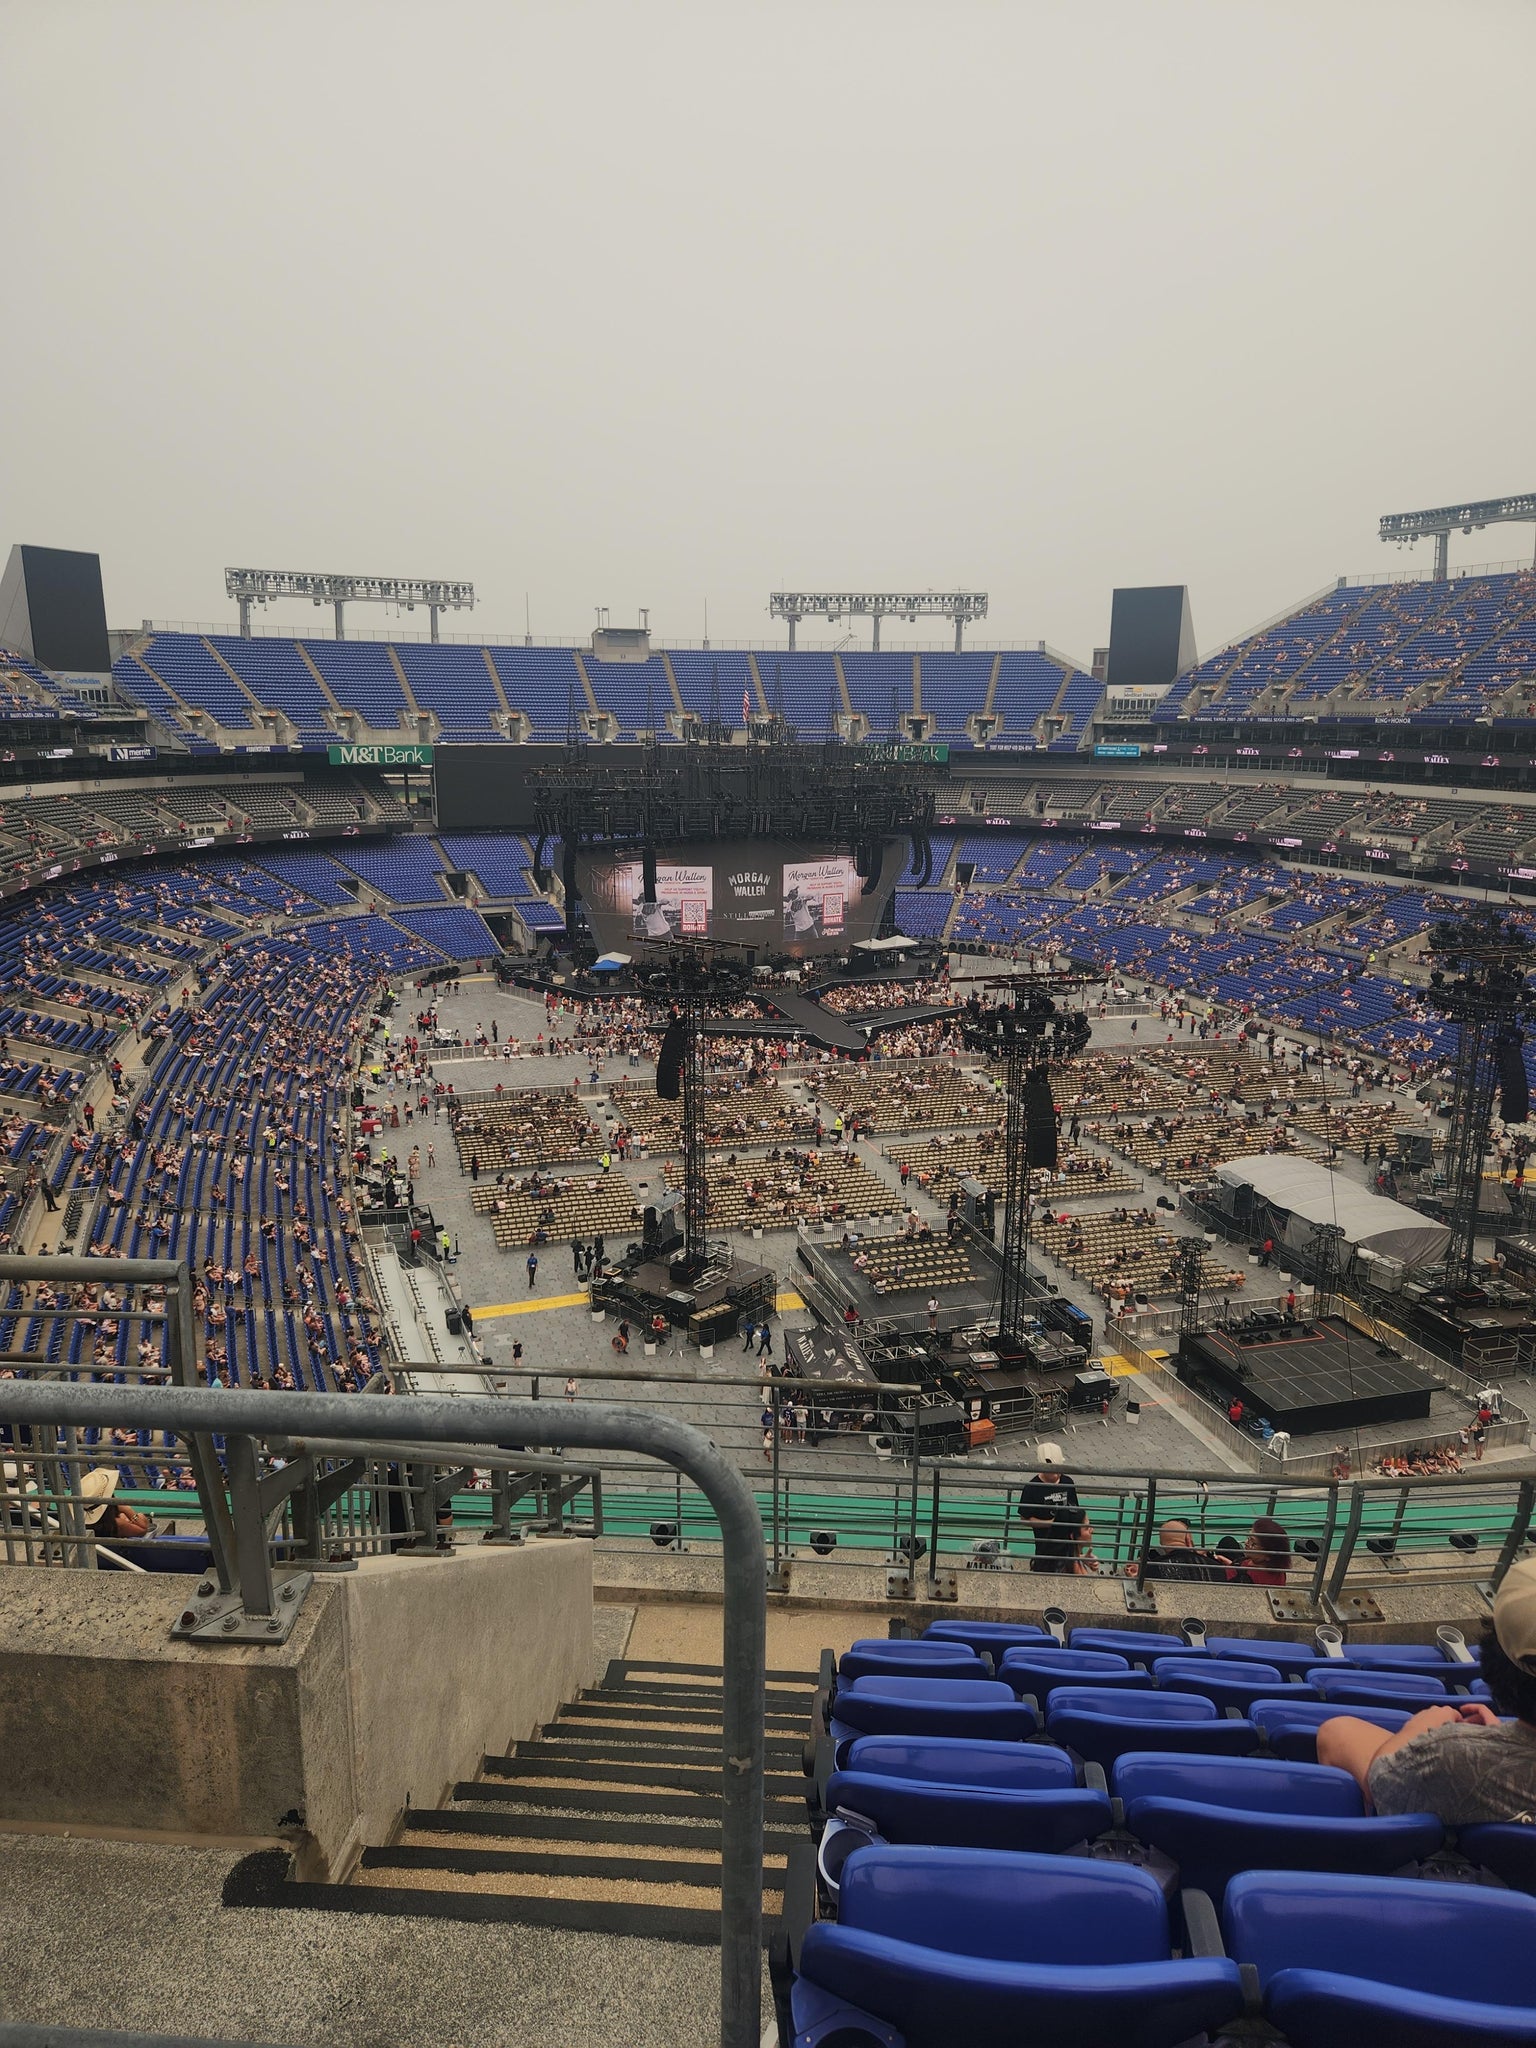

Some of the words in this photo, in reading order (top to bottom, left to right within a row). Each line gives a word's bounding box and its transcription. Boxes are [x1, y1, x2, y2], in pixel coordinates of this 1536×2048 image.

[340, 746, 385, 764] M&T
[385, 746, 424, 763] Bank
[674, 870, 706, 882] Wallen
[728, 872, 770, 886] MORGAN
[788, 870, 817, 881] Morgan
[818, 865, 844, 878] Wallen
[734, 886, 766, 896] WALLEN
